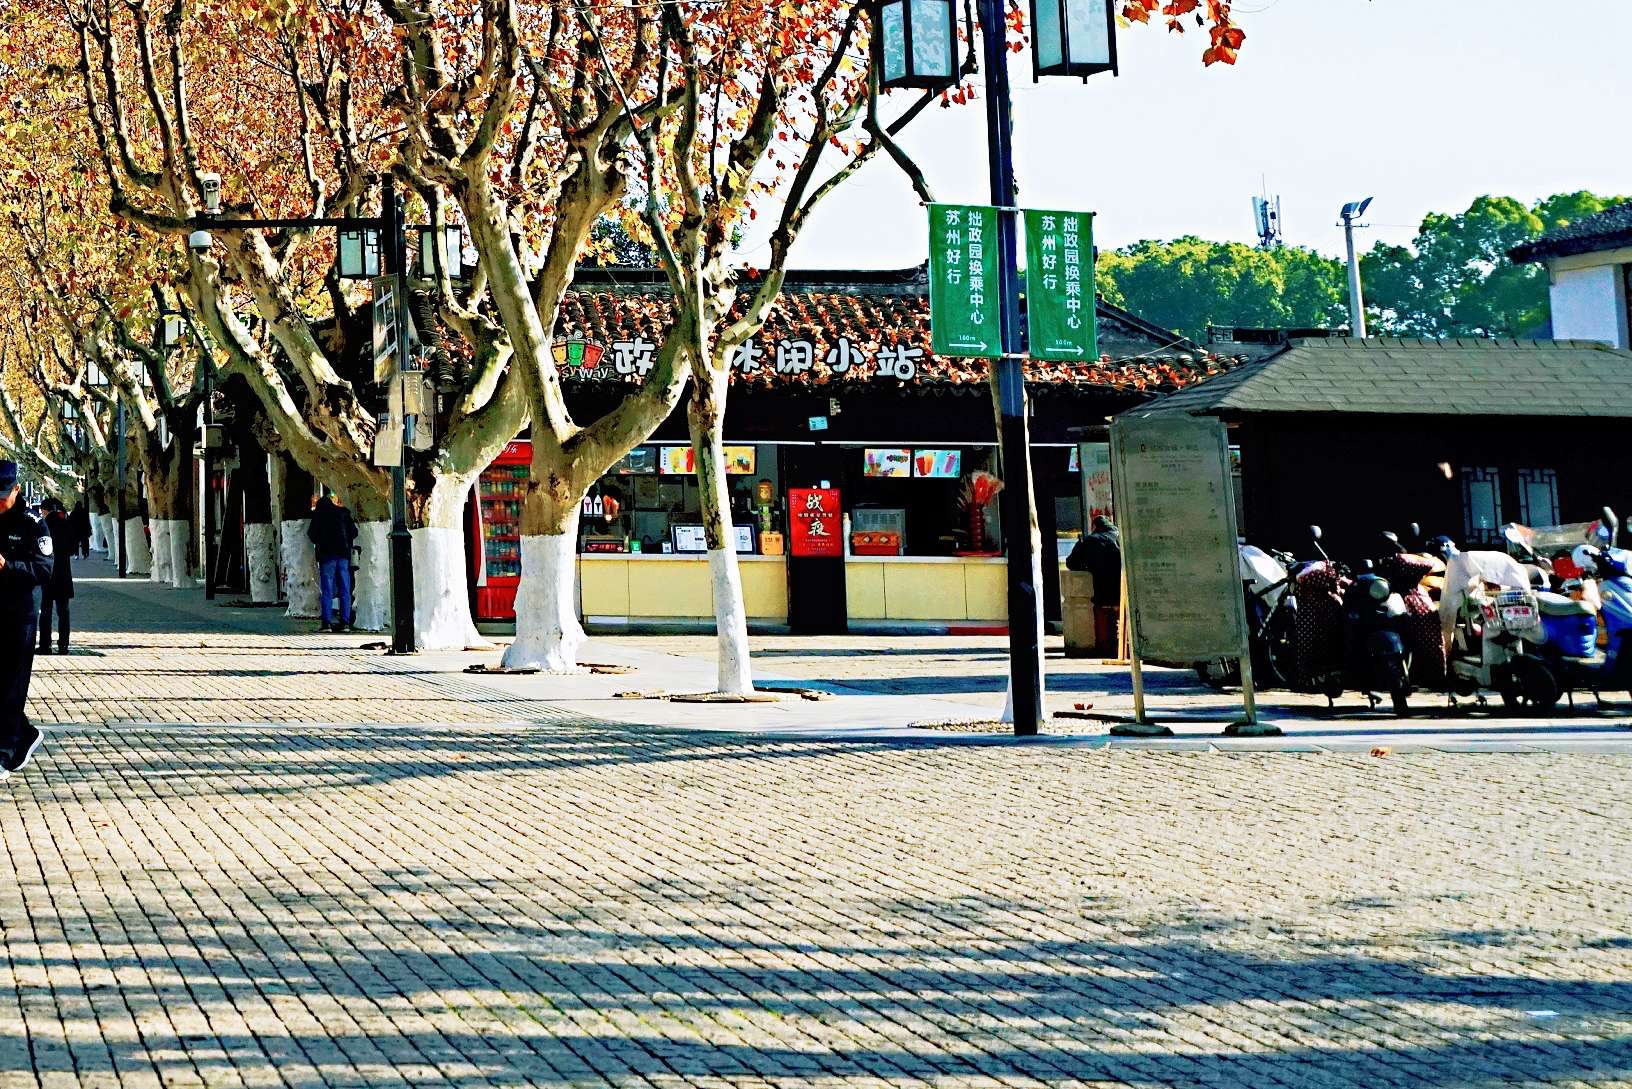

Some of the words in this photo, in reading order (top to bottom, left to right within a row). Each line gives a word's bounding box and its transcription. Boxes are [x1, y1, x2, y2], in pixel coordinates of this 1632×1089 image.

[946, 211, 961, 284] 苏州好行
[968, 212, 984, 325] 拙政园换乘中心
[1042, 216, 1057, 289] 苏州好行
[1064, 218, 1081, 329] 拙政园换乘中心
